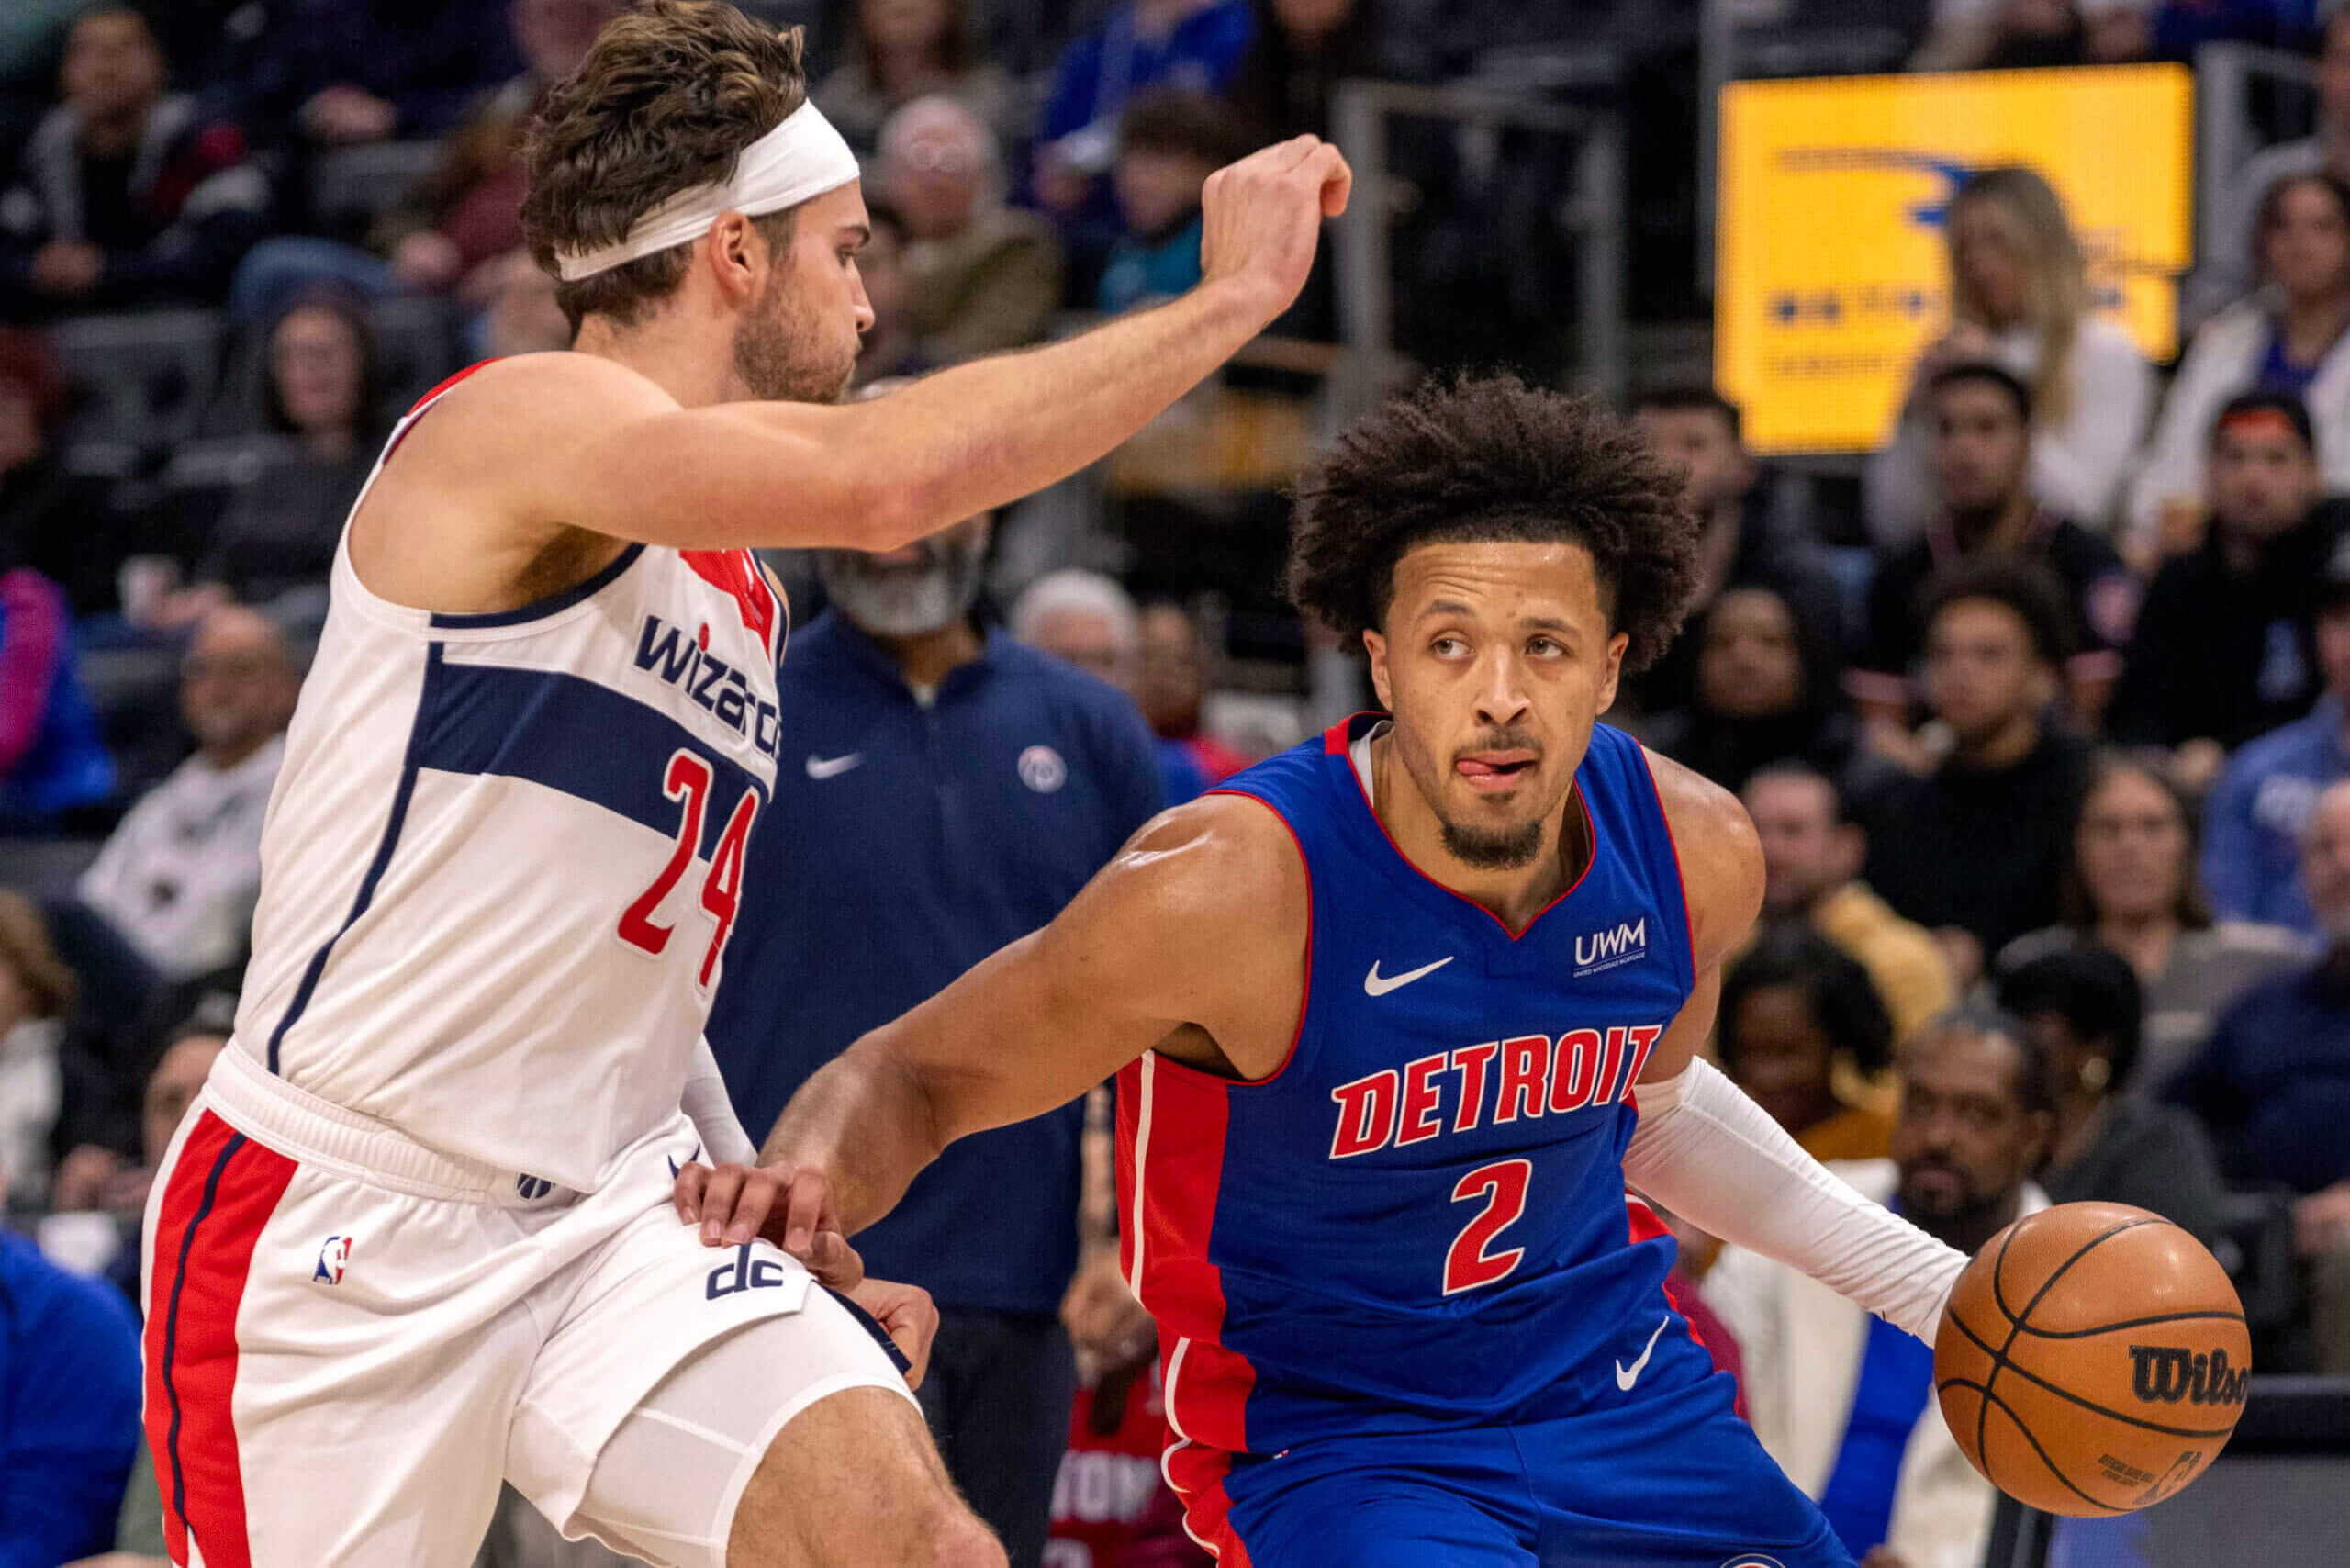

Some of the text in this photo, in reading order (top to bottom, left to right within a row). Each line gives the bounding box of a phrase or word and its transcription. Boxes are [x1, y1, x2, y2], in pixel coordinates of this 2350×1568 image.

[617, 747, 760, 999] 24
[1575, 917, 1646, 966] UWM
[1328, 1024, 1663, 1160] DETROIT
[1442, 1159, 1533, 1297] 2
